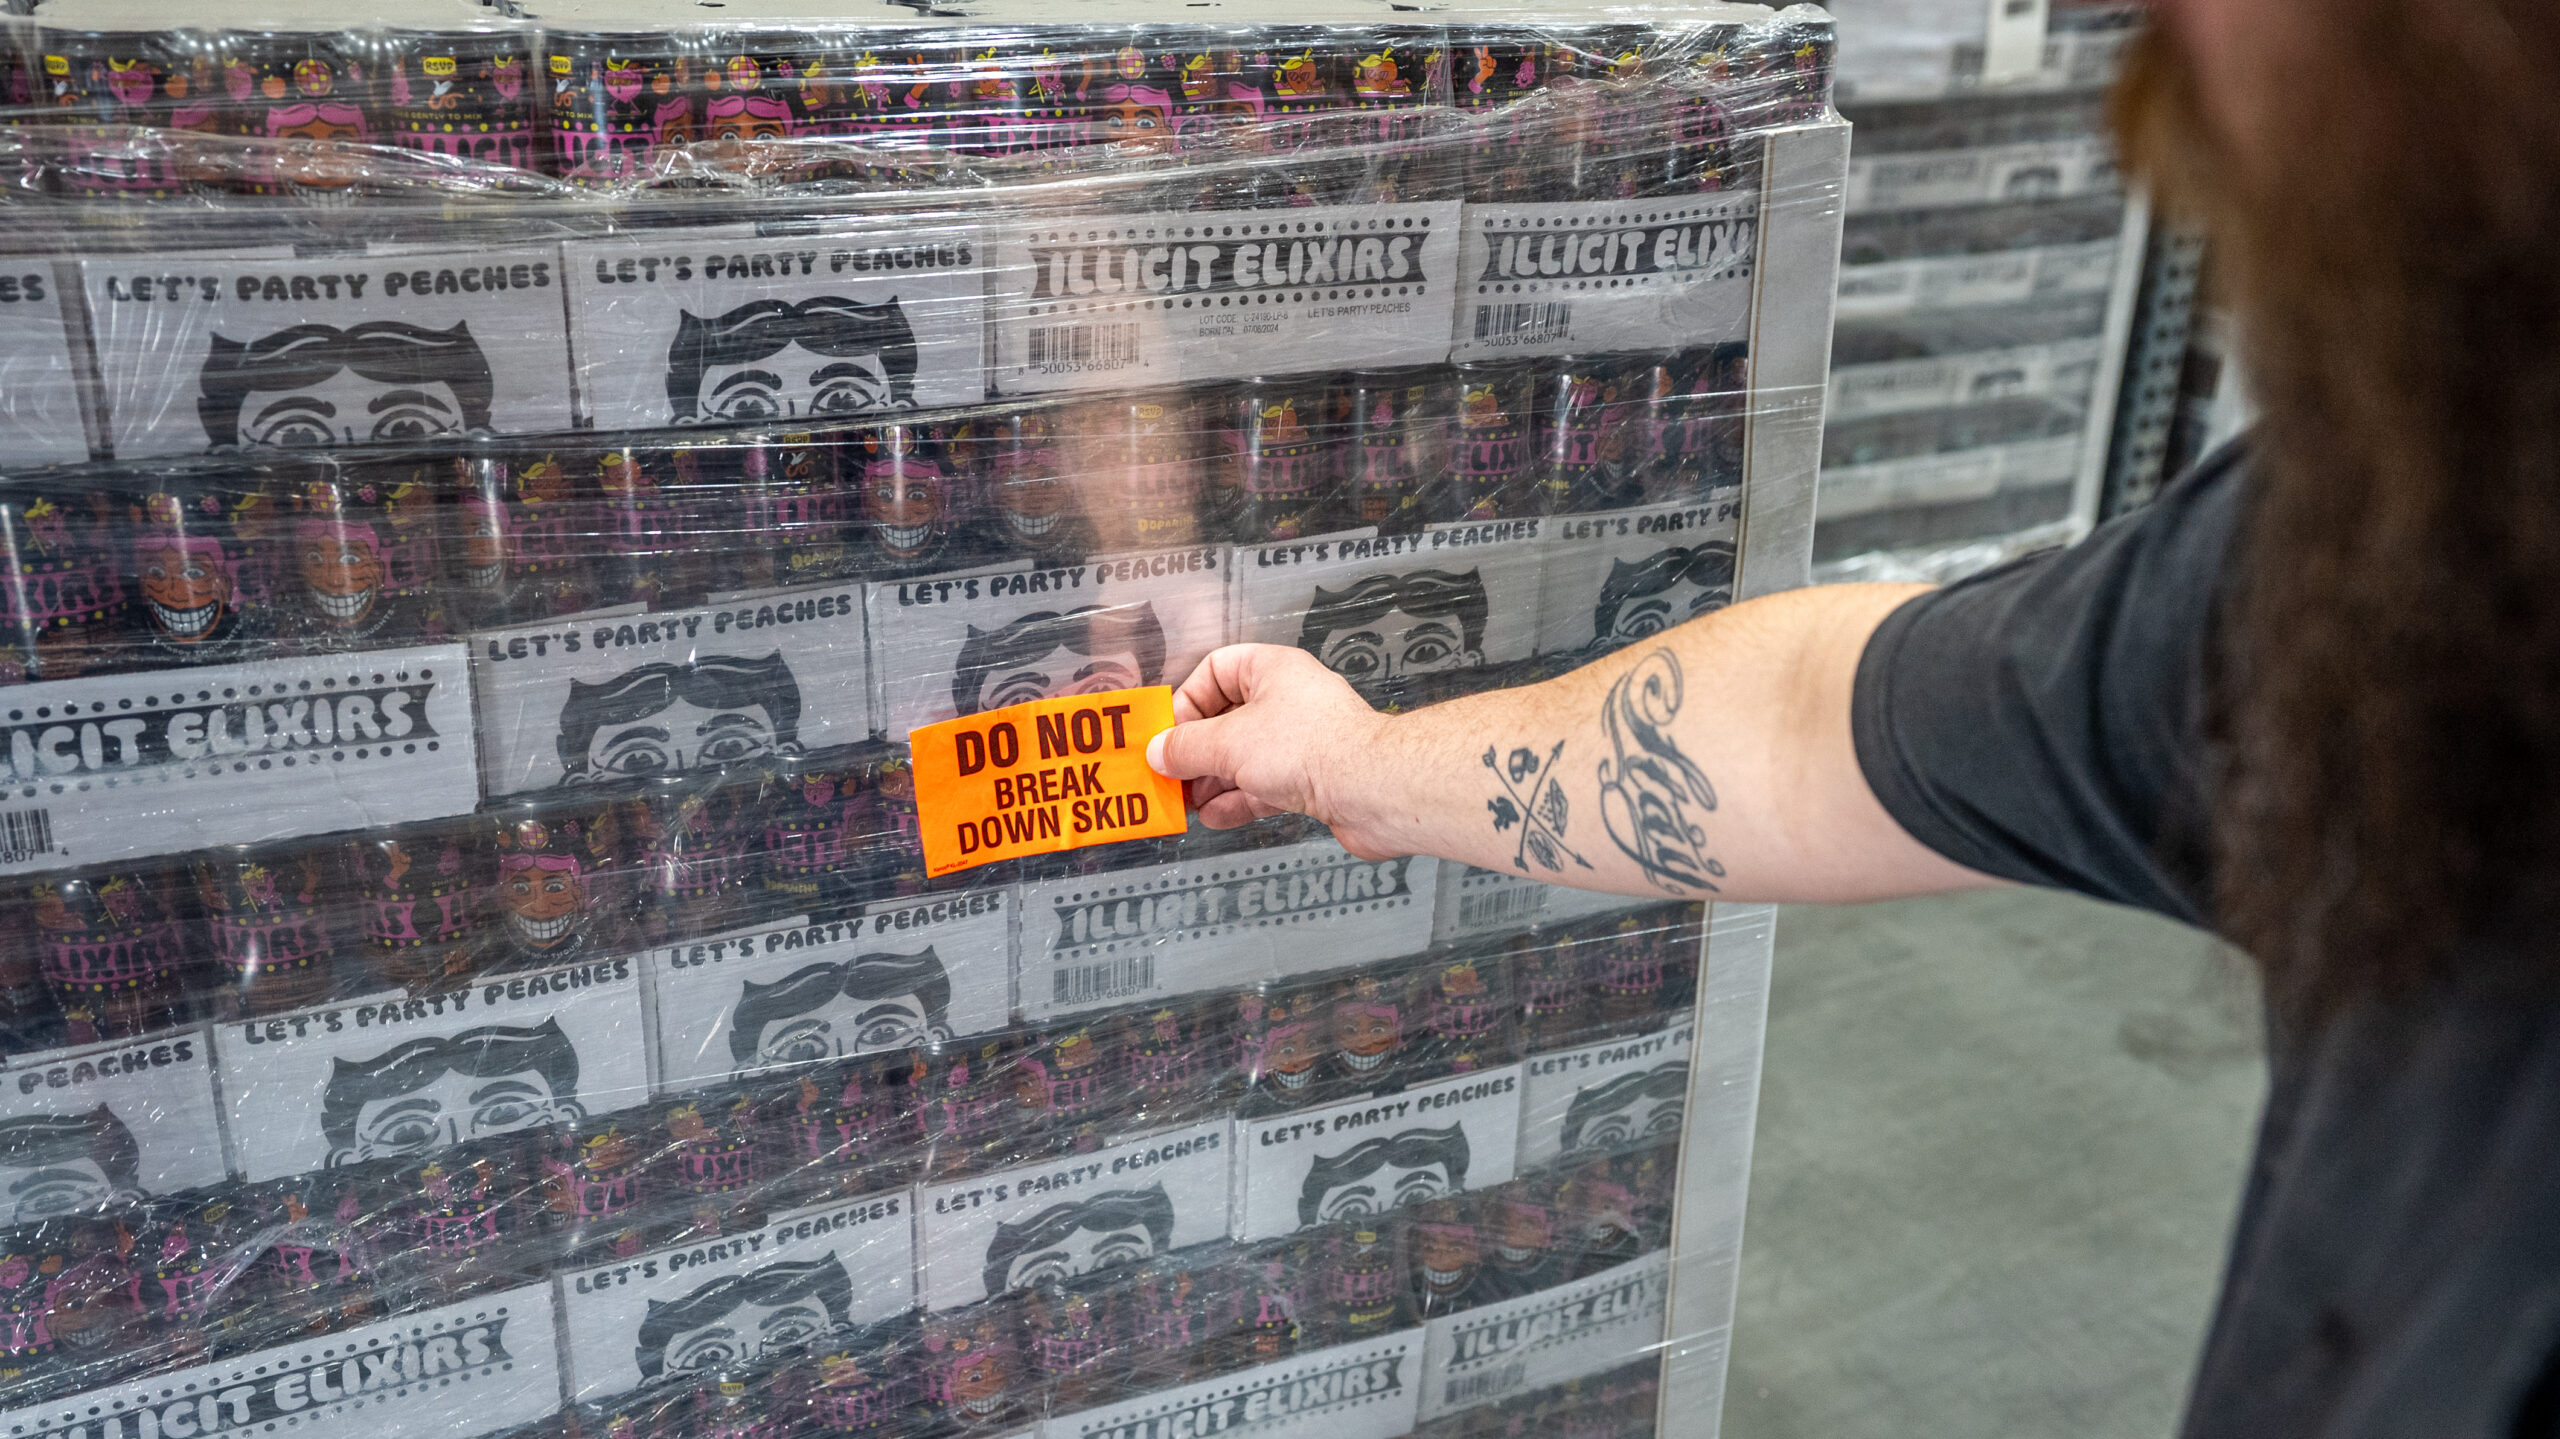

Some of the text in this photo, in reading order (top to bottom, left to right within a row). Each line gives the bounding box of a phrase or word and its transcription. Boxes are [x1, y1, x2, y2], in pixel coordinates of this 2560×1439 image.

[425, 60, 454, 73] RSVP
[107, 263, 550, 302] LET'S PARTY PEACHES
[596, 242, 973, 283] LET'S PARTY PEACHES
[1049, 236, 1411, 297] ILLICIT ELIXIRS
[1500, 231, 1645, 277] ILLICIT
[1307, 302, 1411, 318] LET'S PARTY PEACHES
[1523, 334, 1557, 345] 66807
[1258, 519, 1538, 567] LET'S PARTY PEACHES
[1562, 517, 1630, 540] LET'S
[1637, 508, 1713, 535] PARTY
[899, 549, 1217, 606] LET'S PARTY PEACHES
[488, 594, 852, 661] LET'S PARTY PEACHES
[167, 691, 413, 760] ELIXIRS
[955, 704, 1130, 777] DO NOT
[994, 762, 1105, 810] BREAK
[957, 792, 1149, 855] DOWN SKID
[671, 893, 1001, 969] LET'S PARTY PEACHES
[1071, 860, 1398, 943] ILLICIT ELIXIRS
[246, 1012, 343, 1045] LET'S
[356, 992, 470, 1027] PARTY
[485, 960, 629, 1005] PEACHES
[19, 1041, 193, 1095] PEACHES
[1530, 1053, 1591, 1077] LET'S
[1598, 1036, 1667, 1065] PARTY
[1261, 1077, 1515, 1147] LET'S PARTY PEACHES
[935, 1132, 1220, 1215] LET'S PARTY PEACHES
[576, 1198, 900, 1294] LET'S PARTY PEACHES
[274, 1327, 490, 1412] ELIXIRS
[1244, 1359, 1390, 1421] ELIXIRS
